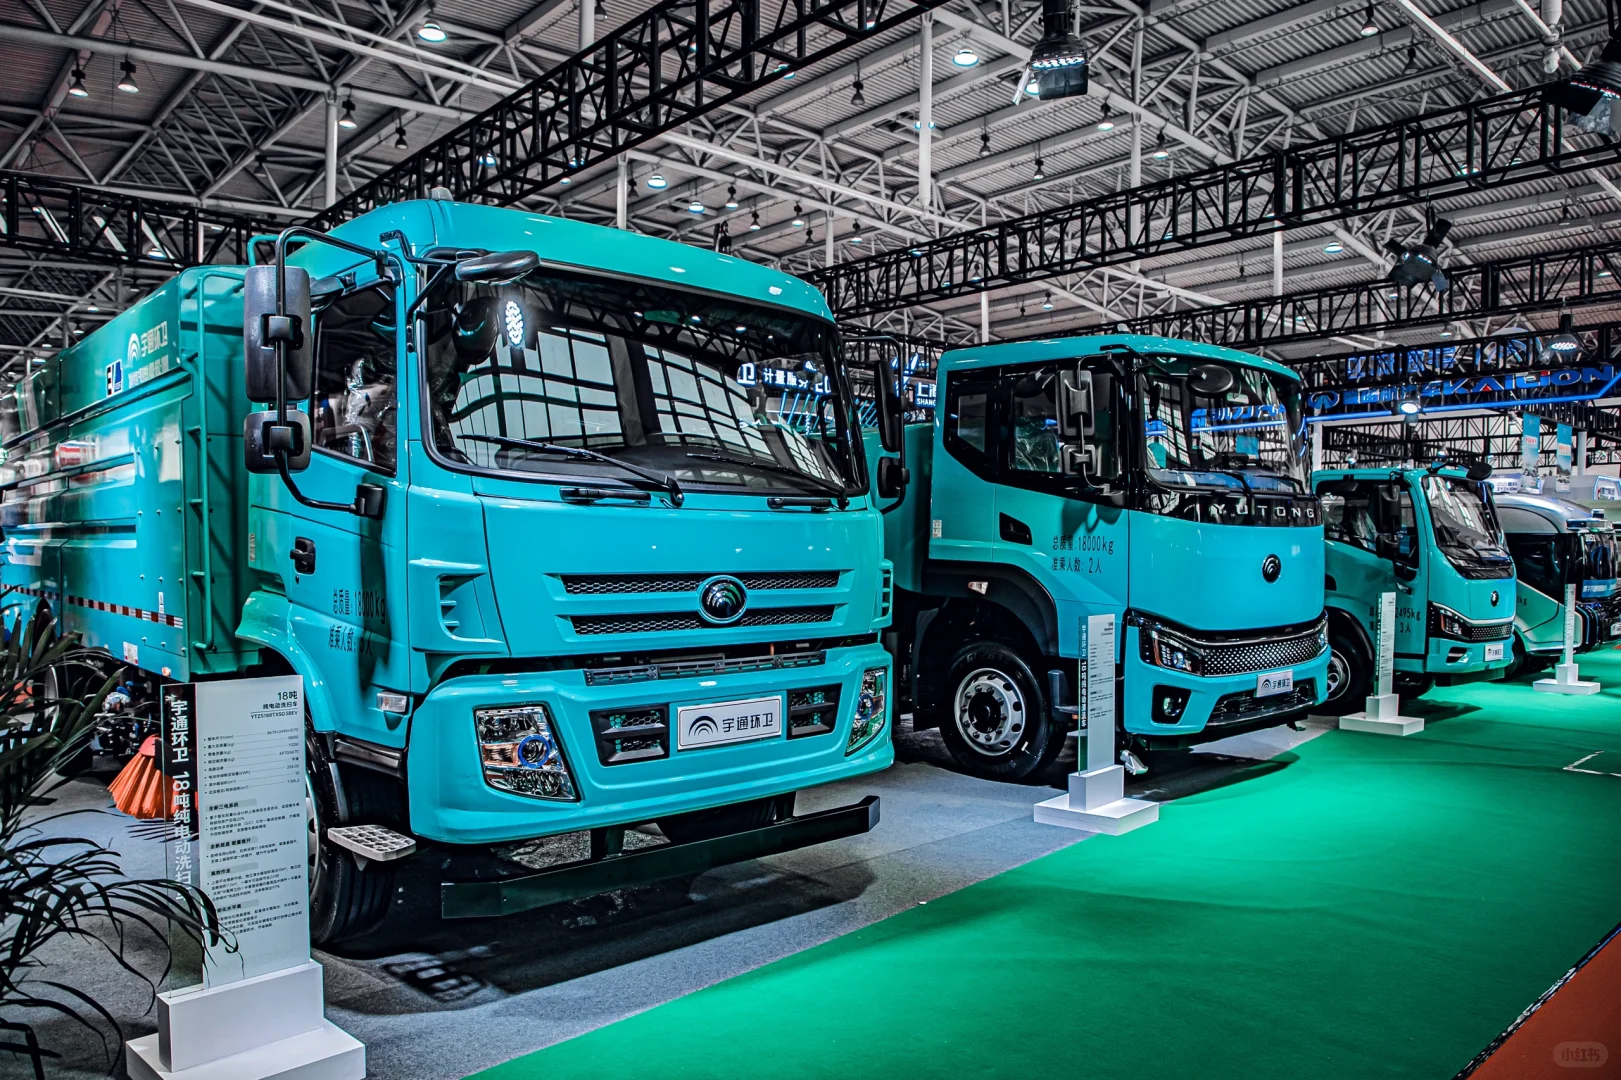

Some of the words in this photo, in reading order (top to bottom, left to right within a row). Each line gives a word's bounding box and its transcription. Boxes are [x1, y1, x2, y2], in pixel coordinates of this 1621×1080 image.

[1211, 503, 1315, 518] YUTONG
[277, 690, 298, 701] 18吨
[262, 701, 298, 710] 纯电动洗扫车
[722, 712, 773, 733] 宇通环卫
[171, 700, 189, 763] 宇通环卫
